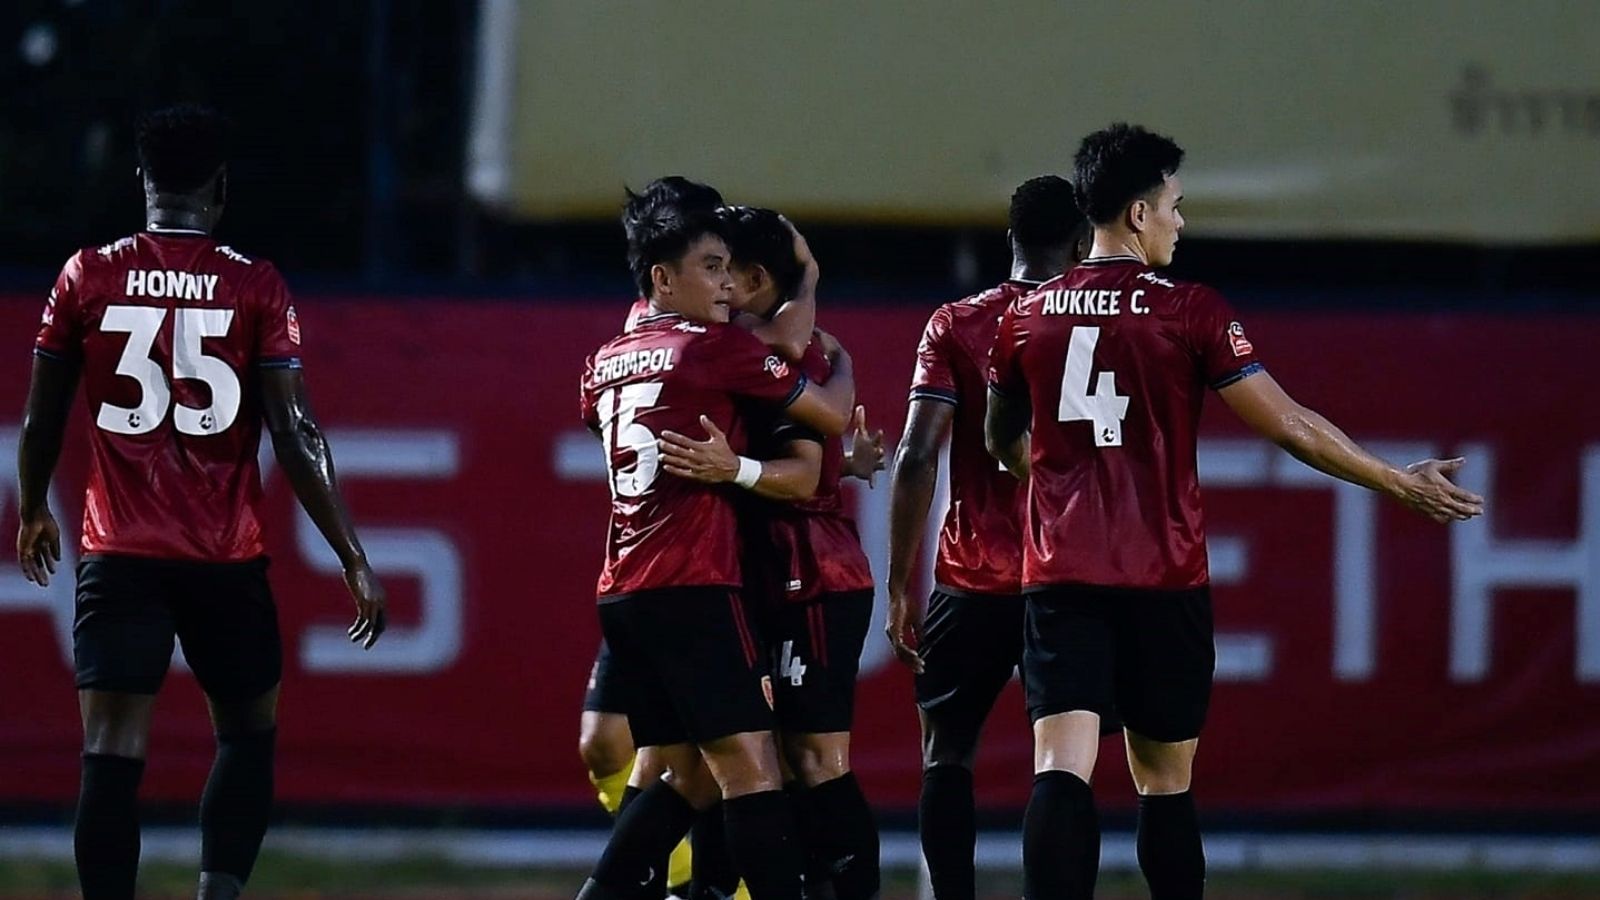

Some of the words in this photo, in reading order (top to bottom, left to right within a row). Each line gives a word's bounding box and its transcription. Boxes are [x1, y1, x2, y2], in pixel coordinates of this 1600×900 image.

[126, 269, 219, 301] HONNY
[1041, 289, 1121, 316] AUKKEE
[1130, 289, 1151, 315] C.
[96, 304, 242, 436] 35
[594, 347, 676, 384] CHUMPOL
[1057, 325, 1131, 448] 4
[597, 381, 664, 499] 15
